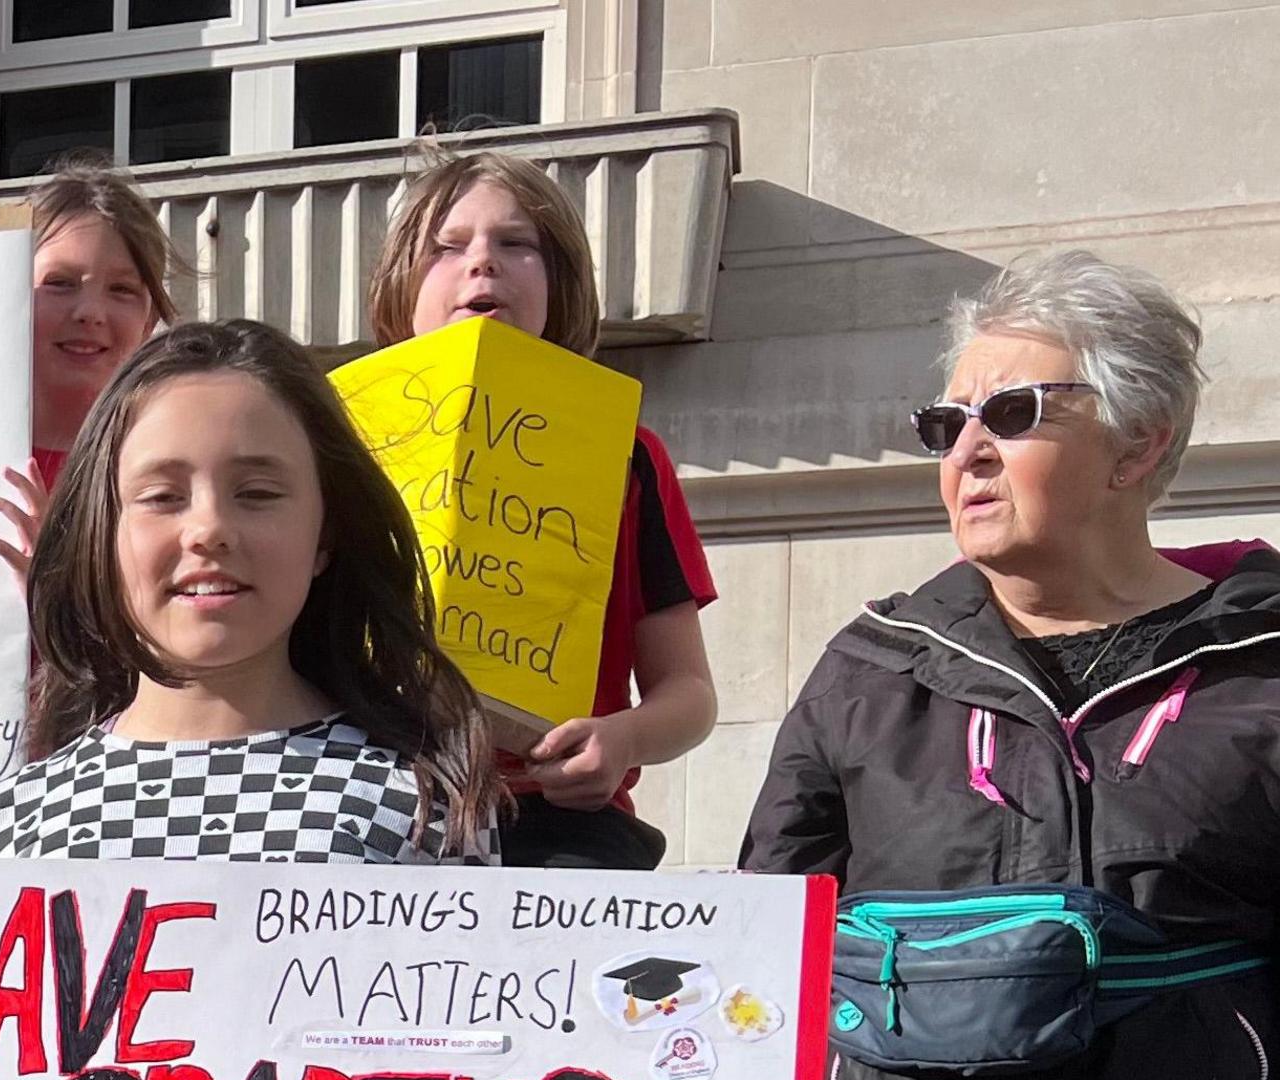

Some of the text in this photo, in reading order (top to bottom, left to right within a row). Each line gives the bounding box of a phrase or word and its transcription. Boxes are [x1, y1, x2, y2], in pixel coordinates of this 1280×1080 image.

[370, 364, 549, 468] Save
[400, 449, 590, 565] cation
[418, 543, 525, 597] owes
[255, 887, 719, 944] BRADING'S EDUCATION
[267, 955, 579, 1035] MATTERS!
[305, 1034, 322, 1045] We
[324, 1035, 340, 1045] are
[341, 1036, 349, 1045] a
[351, 1035, 385, 1046] TEAM
[387, 1035, 405, 1047] that
[407, 1036, 449, 1047] TRUST
[451, 1036, 476, 1049] each
